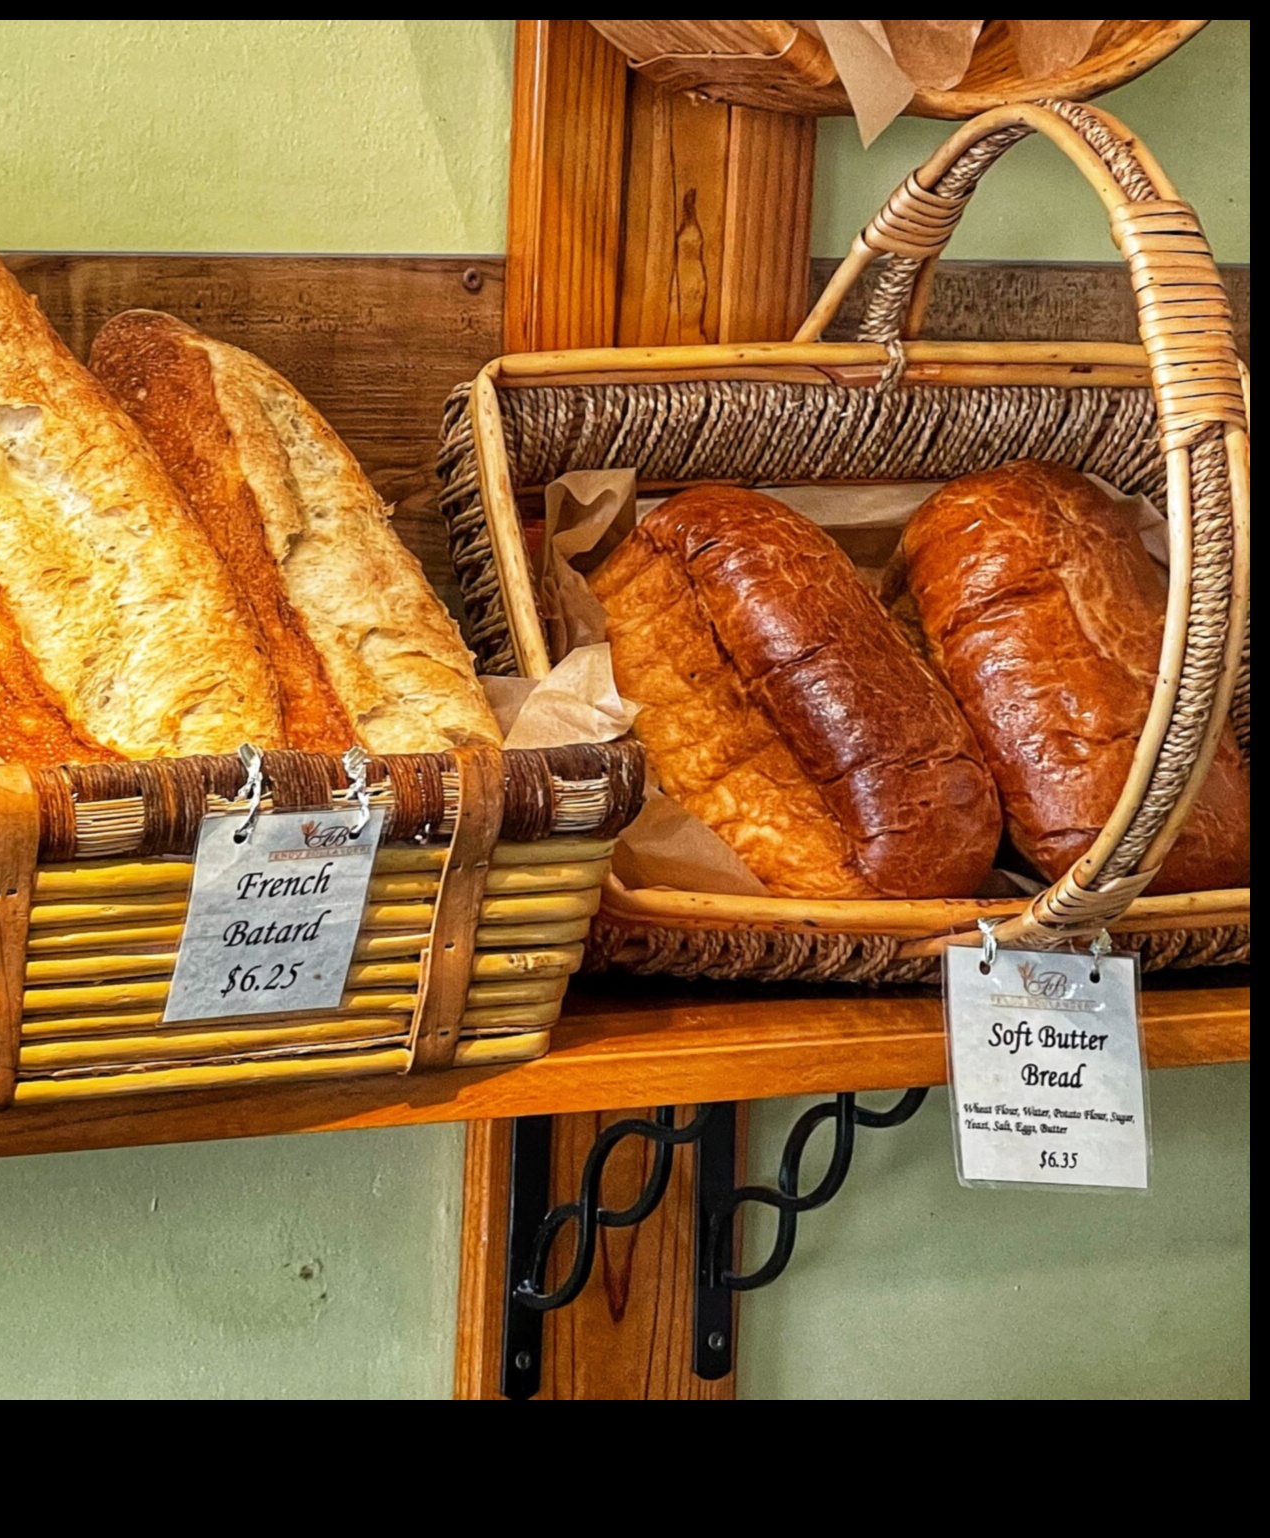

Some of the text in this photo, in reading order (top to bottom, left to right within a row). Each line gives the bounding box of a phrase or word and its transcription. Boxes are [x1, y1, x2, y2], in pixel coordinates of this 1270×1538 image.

[236, 862, 334, 900] French
[222, 910, 332, 947] Batard
[220, 961, 305, 998] $6.25
[988, 1021, 1108, 1054] Soft Butter
[1021, 1063, 1087, 1089] Bread
[963, 1102, 1135, 1125] Wheat Flour, Water, Potato Flour, Sugar,
[965, 1119, 1068, 1136] Yeast, Salt, Eggs, Butter
[1039, 1150, 1079, 1170] $6.35
